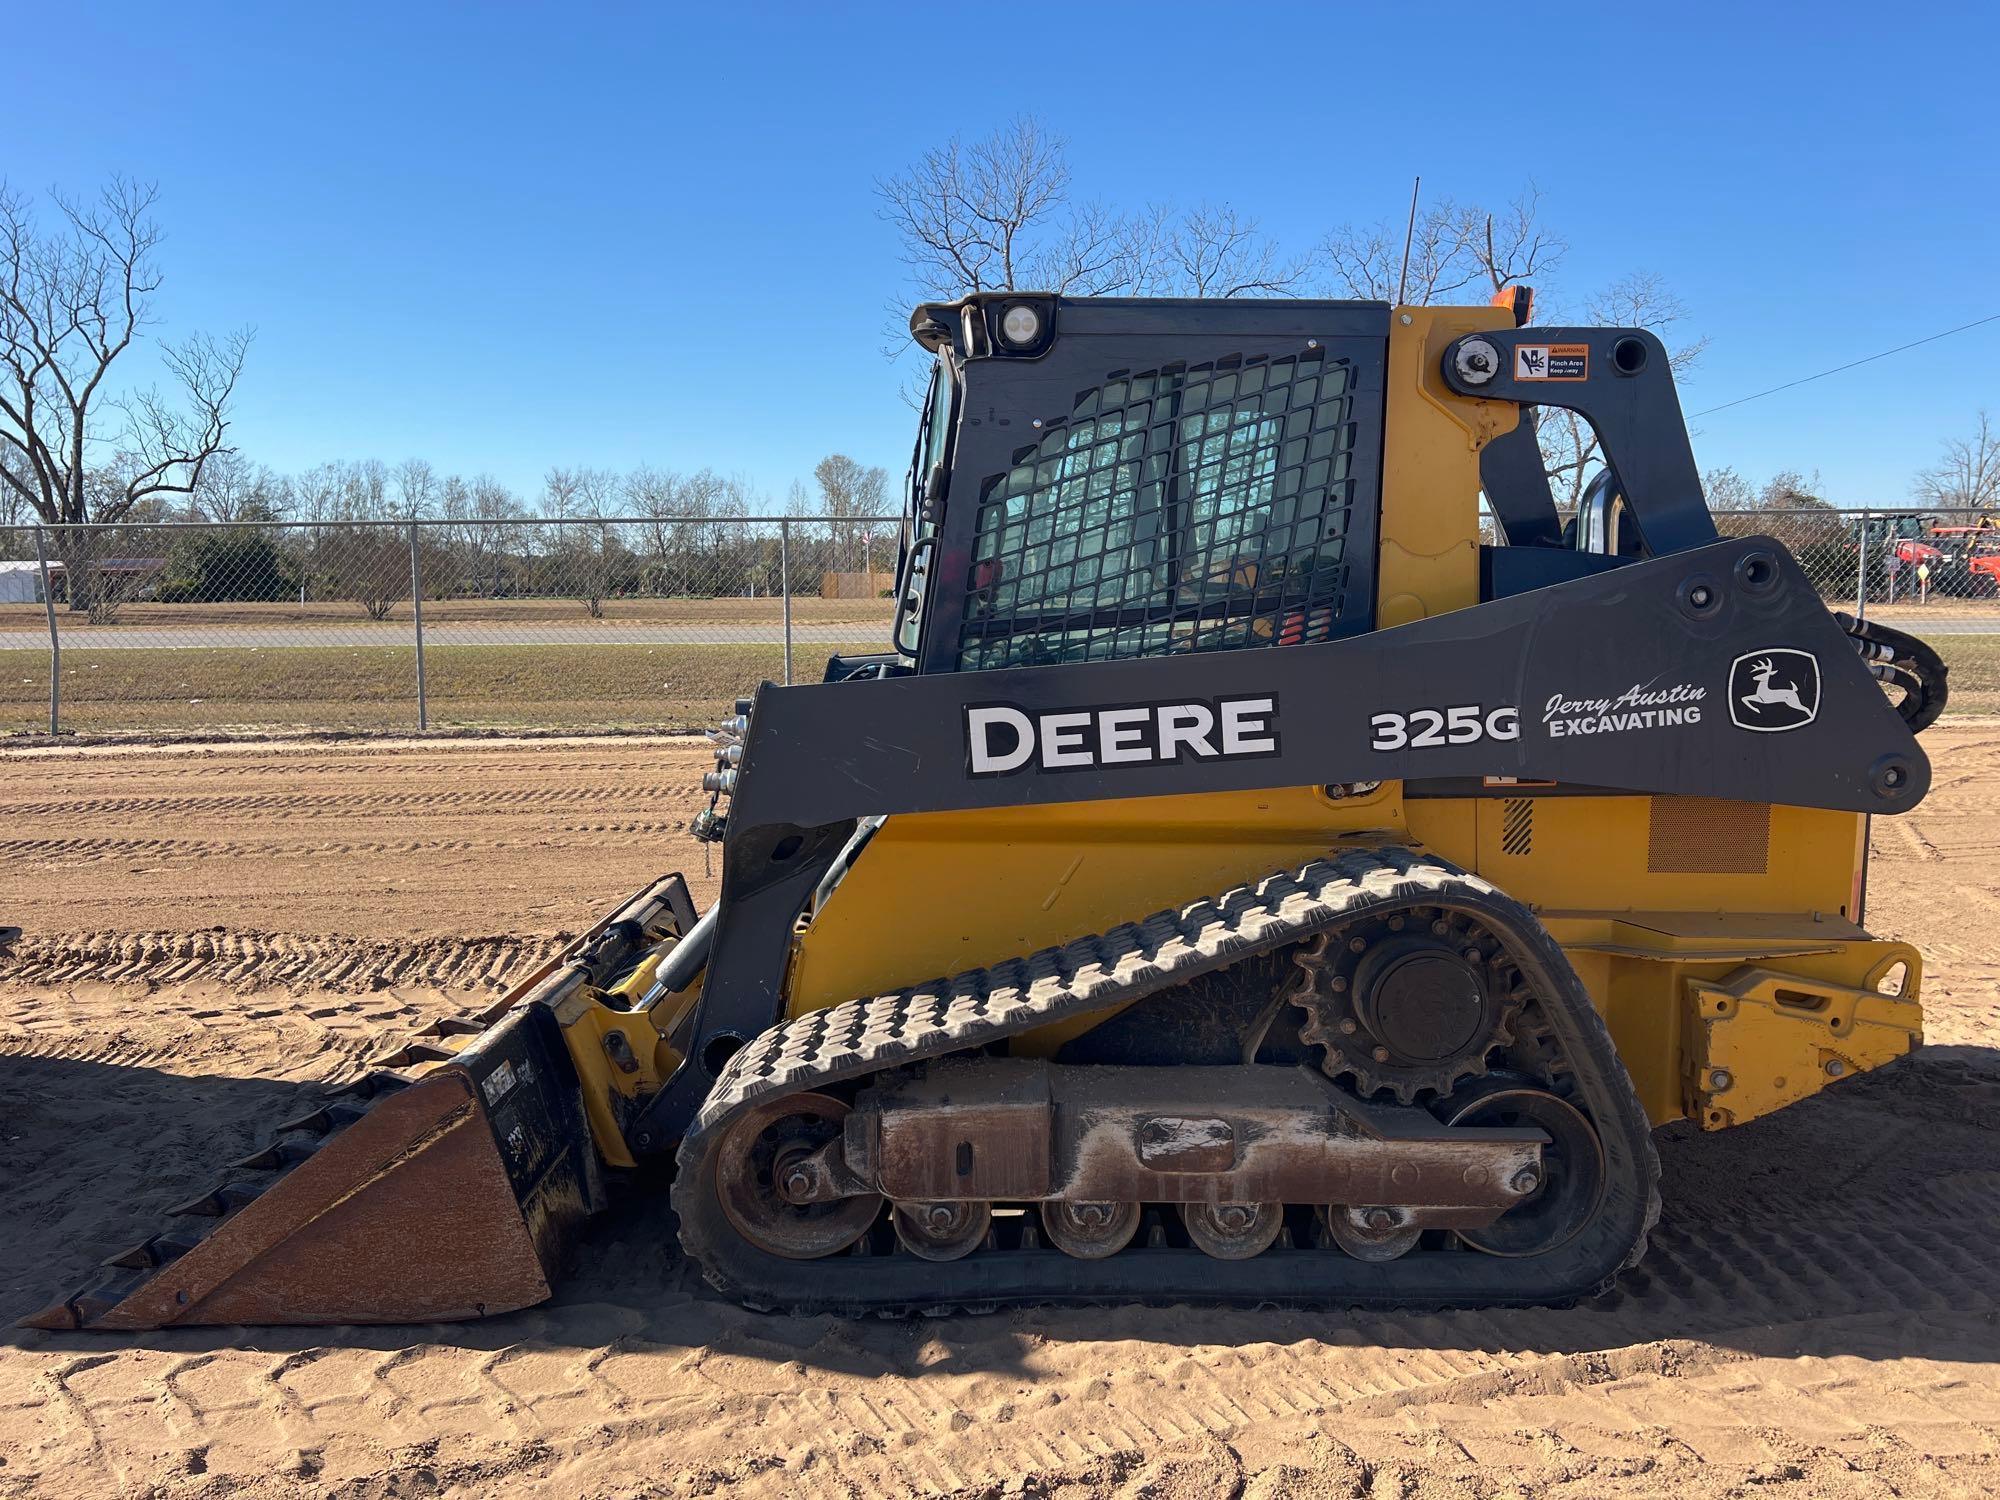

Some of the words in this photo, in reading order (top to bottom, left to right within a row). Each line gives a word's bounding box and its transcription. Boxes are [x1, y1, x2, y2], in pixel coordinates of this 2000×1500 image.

[1542, 693, 1612, 723] Jerry
[1615, 684, 1707, 717] Austin
[1549, 706, 1702, 738] EXCAVATING
[968, 698, 1275, 773] DEERE
[1371, 706, 1520, 752] 325G
